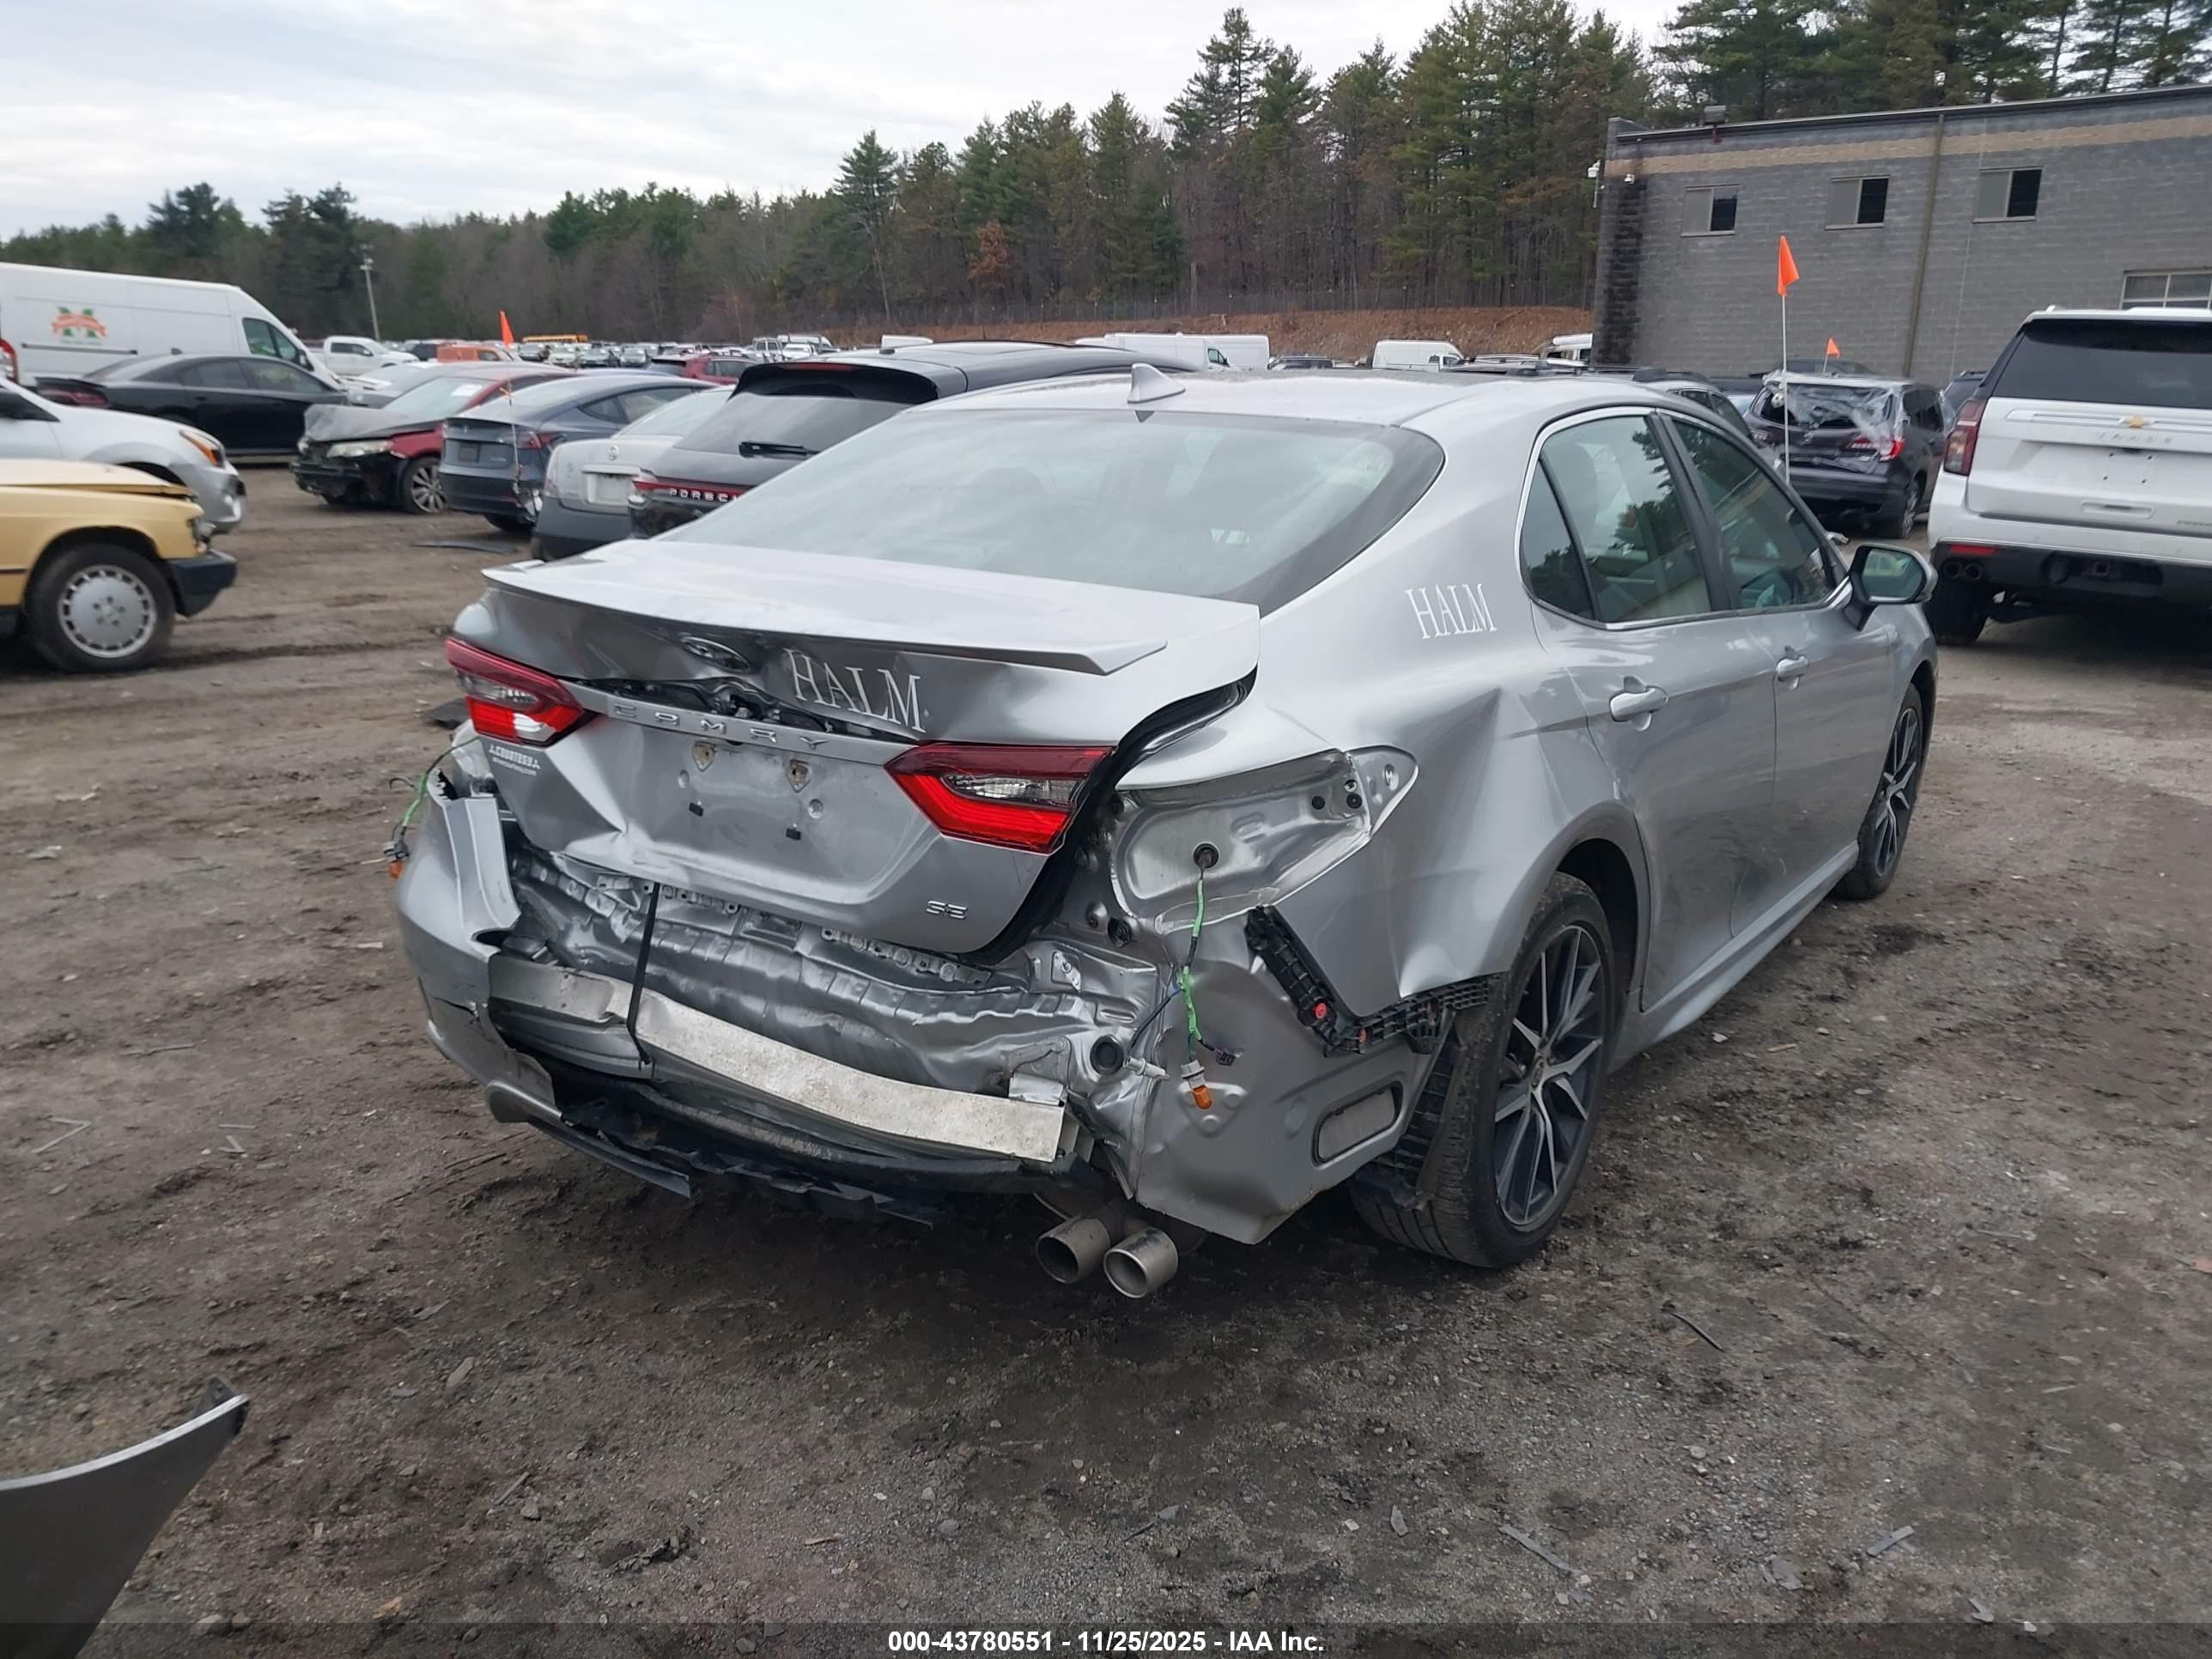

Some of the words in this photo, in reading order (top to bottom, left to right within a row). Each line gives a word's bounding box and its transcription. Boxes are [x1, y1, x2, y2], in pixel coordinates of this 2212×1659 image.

[1404, 583, 1498, 639] HALM
[783, 647, 927, 733] HALM
[613, 704, 829, 750] CAMRY
[927, 900, 968, 919] SE
